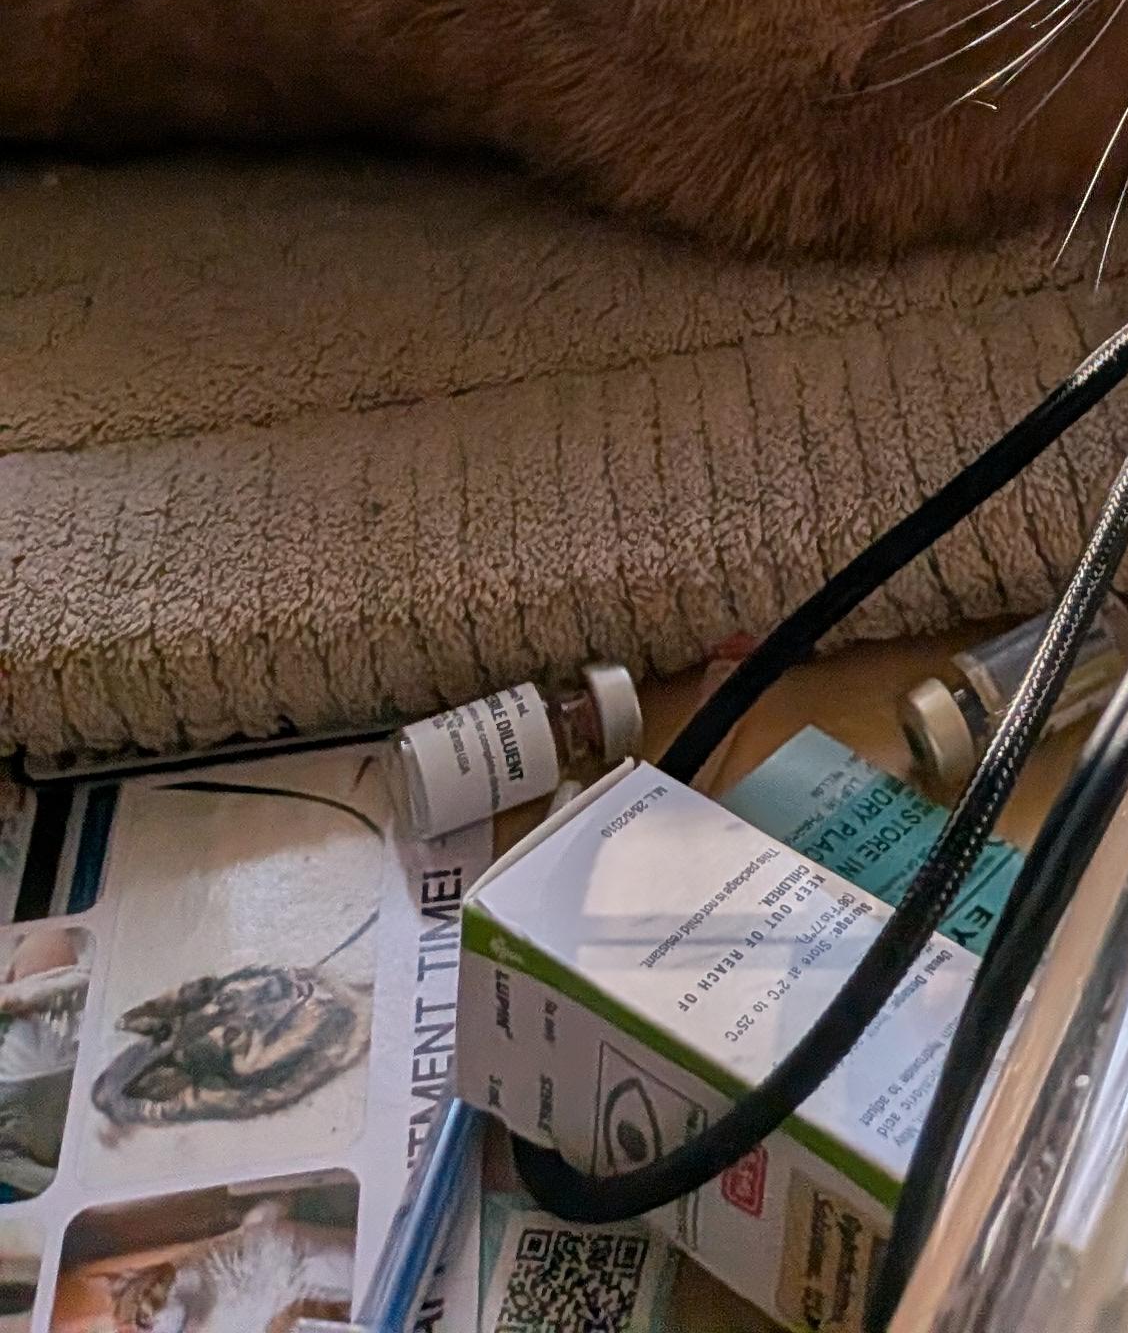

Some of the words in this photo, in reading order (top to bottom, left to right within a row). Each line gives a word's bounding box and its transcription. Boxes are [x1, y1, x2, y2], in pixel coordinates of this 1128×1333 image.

[495, 719, 525, 782] DILUENT
[855, 787, 894, 826] DRY
[807, 821, 858, 863] PLAC
[855, 808, 922, 864] STORE
[755, 847, 781, 865] This
[723, 861, 761, 895] package
[757, 864, 811, 908] CHILDREN.
[793, 873, 827, 903] KEEP
[700, 899, 720, 917] not
[714, 891, 730, 903] is
[416, 866, 463, 983] TIME!
[679, 912, 706, 936] child
[763, 903, 793, 930] OUT
[829, 901, 874, 939] Storage:
[950, 904, 995, 947] EY
[743, 930, 765, 949] OF
[801, 939, 833, 967] Store
[697, 948, 745, 992] REACH
[787, 966, 802, 980] at
[677, 992, 698, 1013] OF
[752, 999, 769, 1013] to
[858, 1094, 890, 1127] adjust
[875, 1110, 901, 1139] acid
